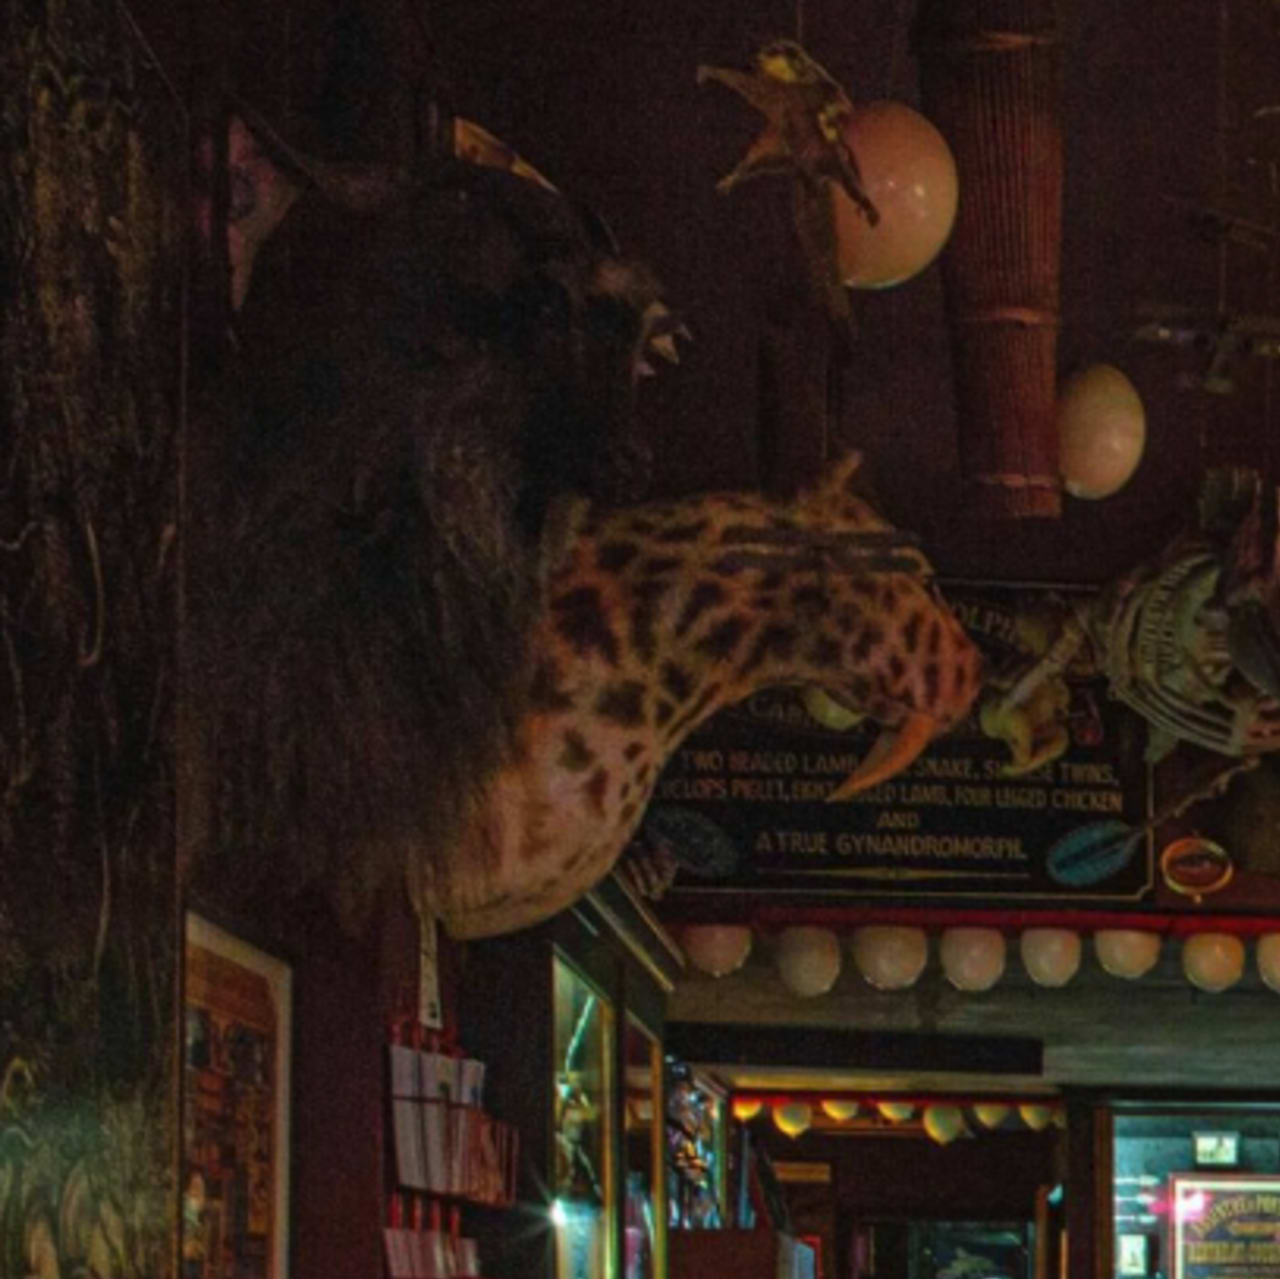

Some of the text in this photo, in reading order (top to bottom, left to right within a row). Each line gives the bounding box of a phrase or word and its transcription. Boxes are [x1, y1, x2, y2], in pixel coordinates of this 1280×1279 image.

[876, 811, 920, 829] AND
[755, 831, 771, 852] A
[776, 831, 829, 855] TRUE
